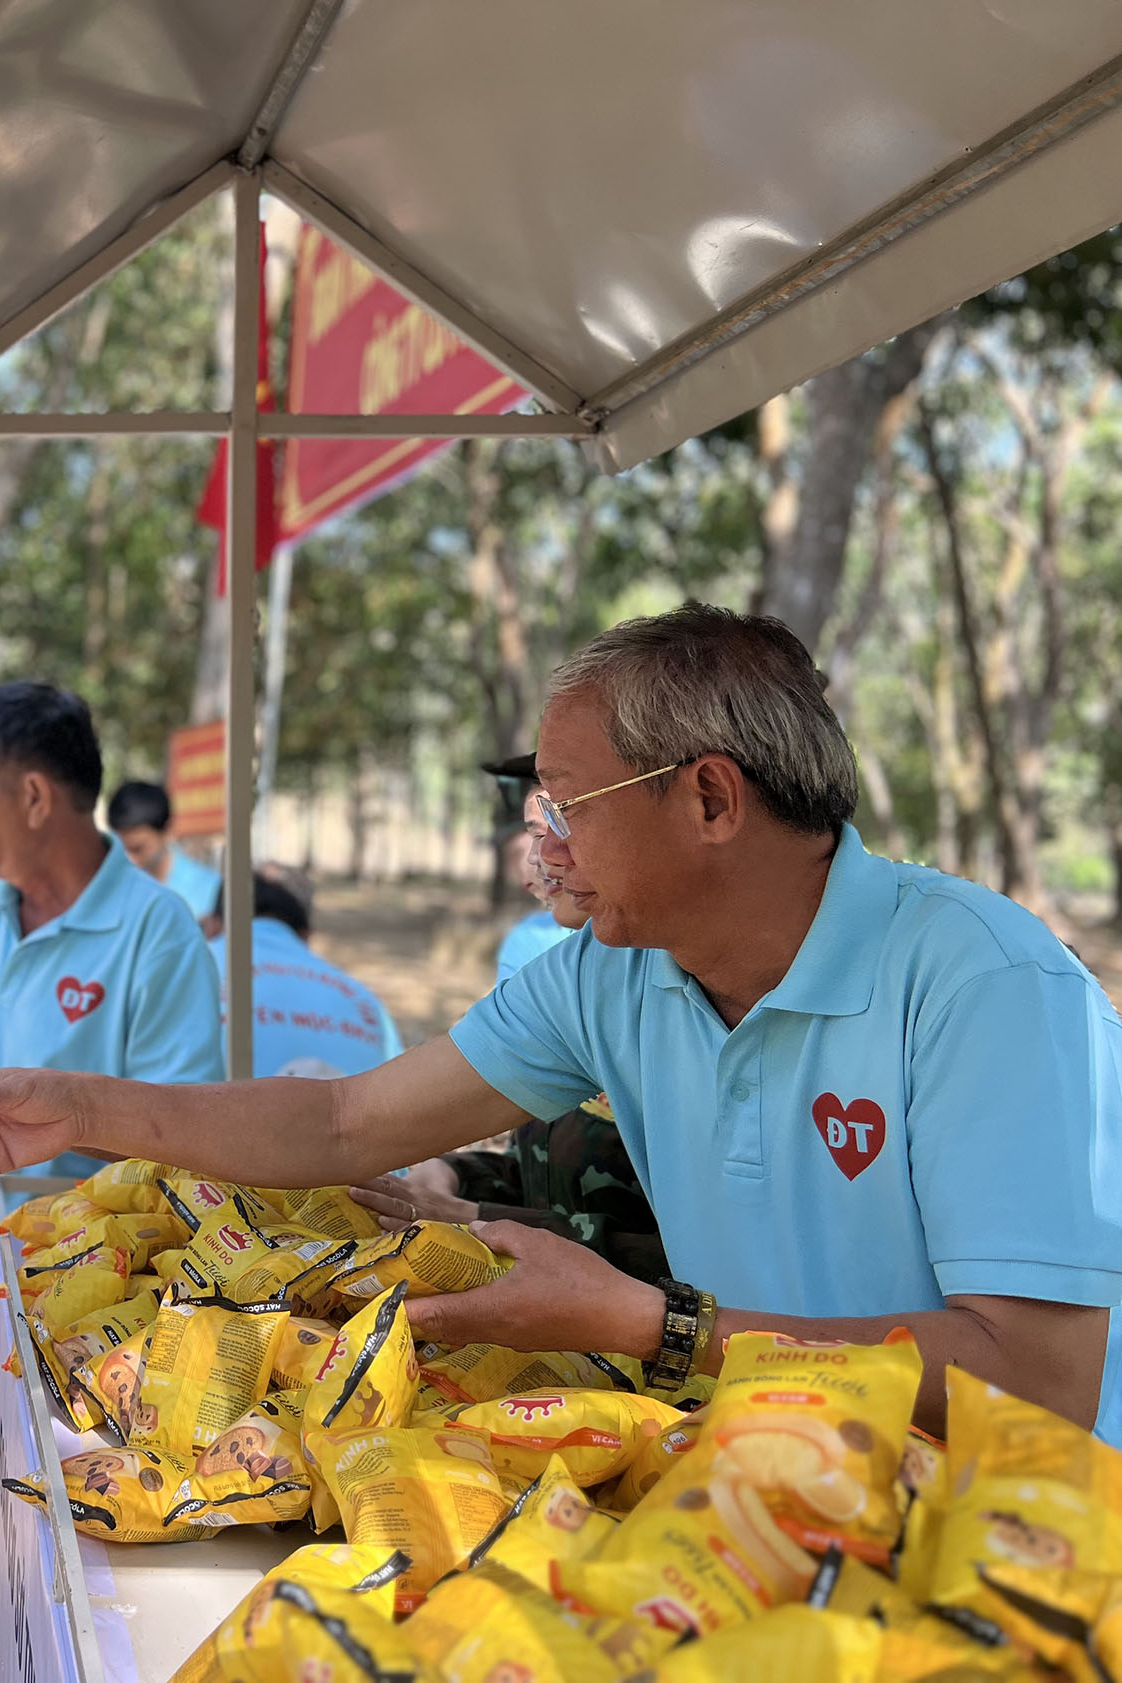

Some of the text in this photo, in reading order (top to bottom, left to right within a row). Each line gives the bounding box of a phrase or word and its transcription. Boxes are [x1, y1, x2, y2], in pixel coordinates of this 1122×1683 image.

[826, 1116, 874, 1153] ĐT
[203, 1233, 234, 1266] KINH DO
[756, 1352, 849, 1366] KINH DO
[335, 1436, 389, 1473] KINH D
